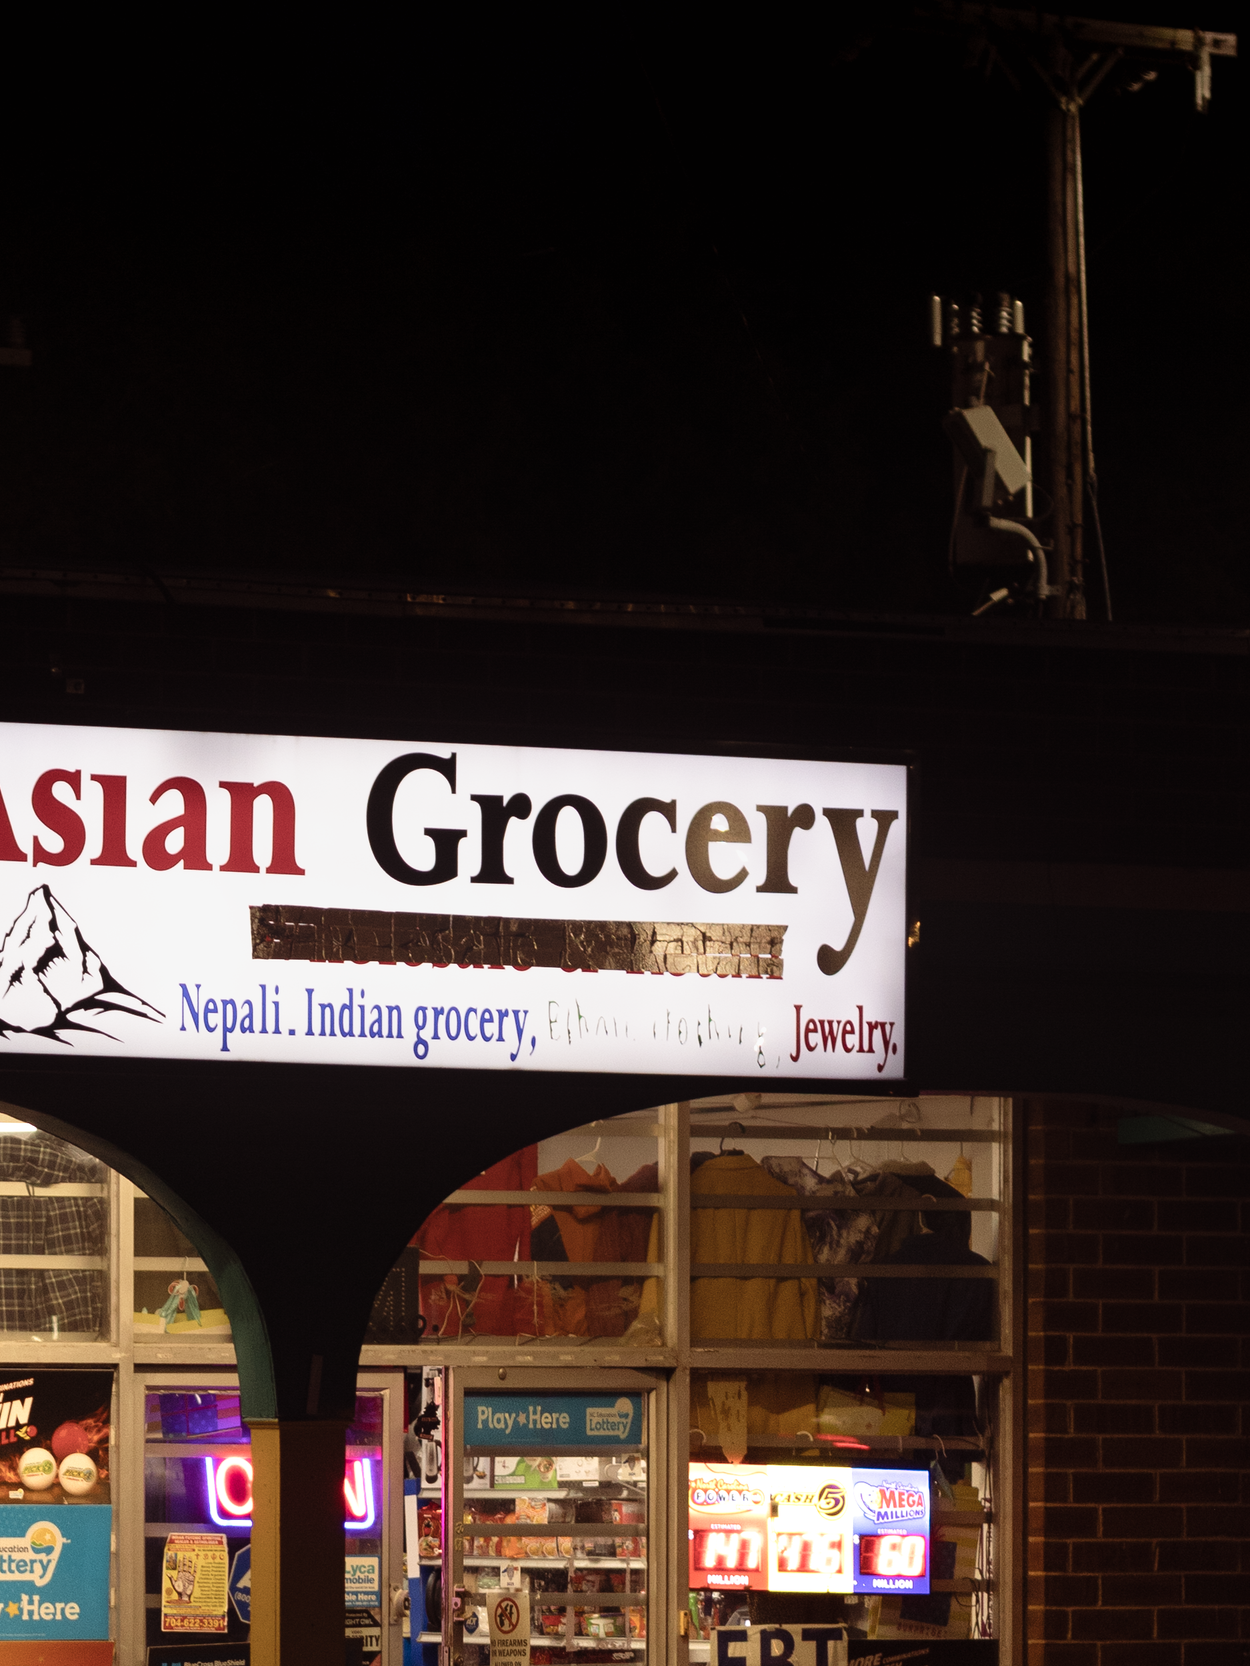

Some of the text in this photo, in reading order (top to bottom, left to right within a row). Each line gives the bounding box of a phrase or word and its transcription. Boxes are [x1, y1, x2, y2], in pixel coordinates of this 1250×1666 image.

[365, 751, 899, 976] Grocery
[305, 987, 404, 1039] Indian
[413, 1005, 536, 1062] grocery,
[790, 1004, 897, 1073] Jewelry.
[477, 1405, 570, 1434] Play Here
[589, 1418, 628, 1434] Lottery
[878, 1488, 924, 1509] MEGA
[876, 1508, 924, 1522] MILLIONS
[878, 1535, 925, 1576] 60
[707, 1575, 749, 1585] MILLION
[873, 1579, 913, 1589] MILLION
[21, 1594, 80, 1621] Here
[165, 1618, 224, 1627] 704-622-3391
[497, 1638, 528, 1647] FIREARMS
[500, 1649, 527, 1657] WEAPONS
